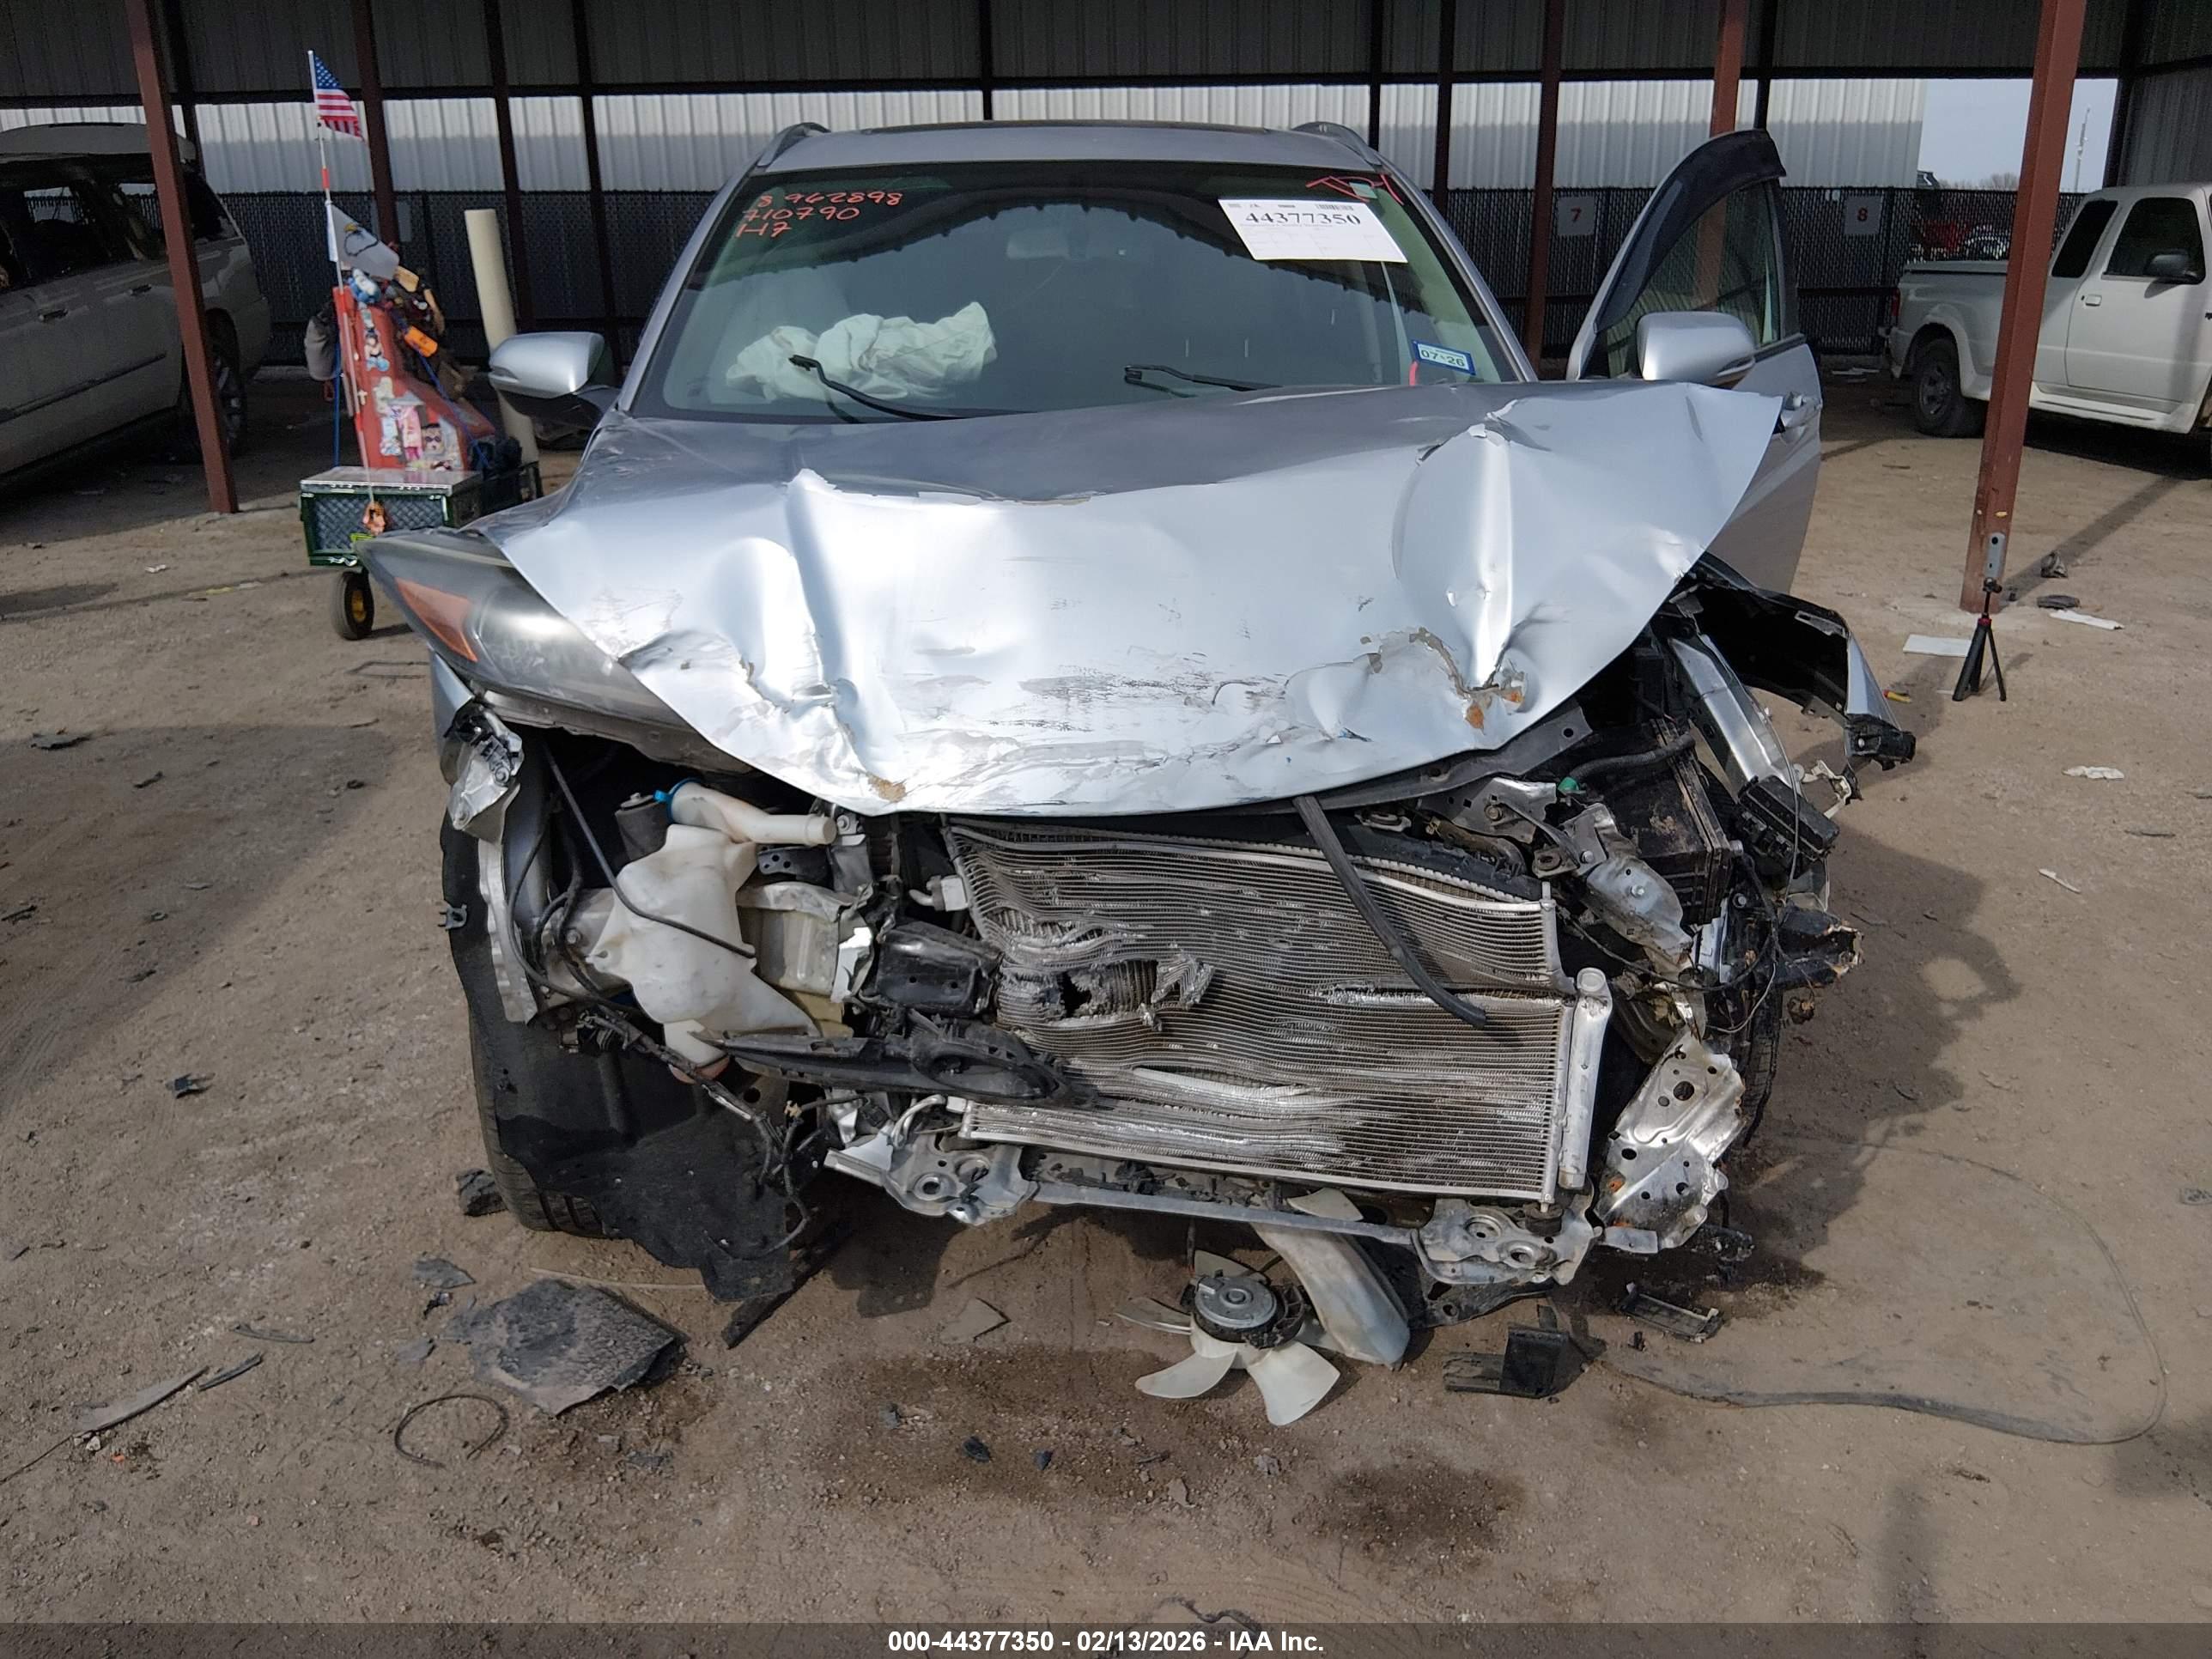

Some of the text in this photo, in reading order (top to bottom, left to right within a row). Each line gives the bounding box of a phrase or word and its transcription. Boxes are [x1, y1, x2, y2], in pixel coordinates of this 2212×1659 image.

[1245, 212, 1361, 225] 44377350
[1571, 207, 1582, 222] 7
[1856, 207, 1869, 222] 8
